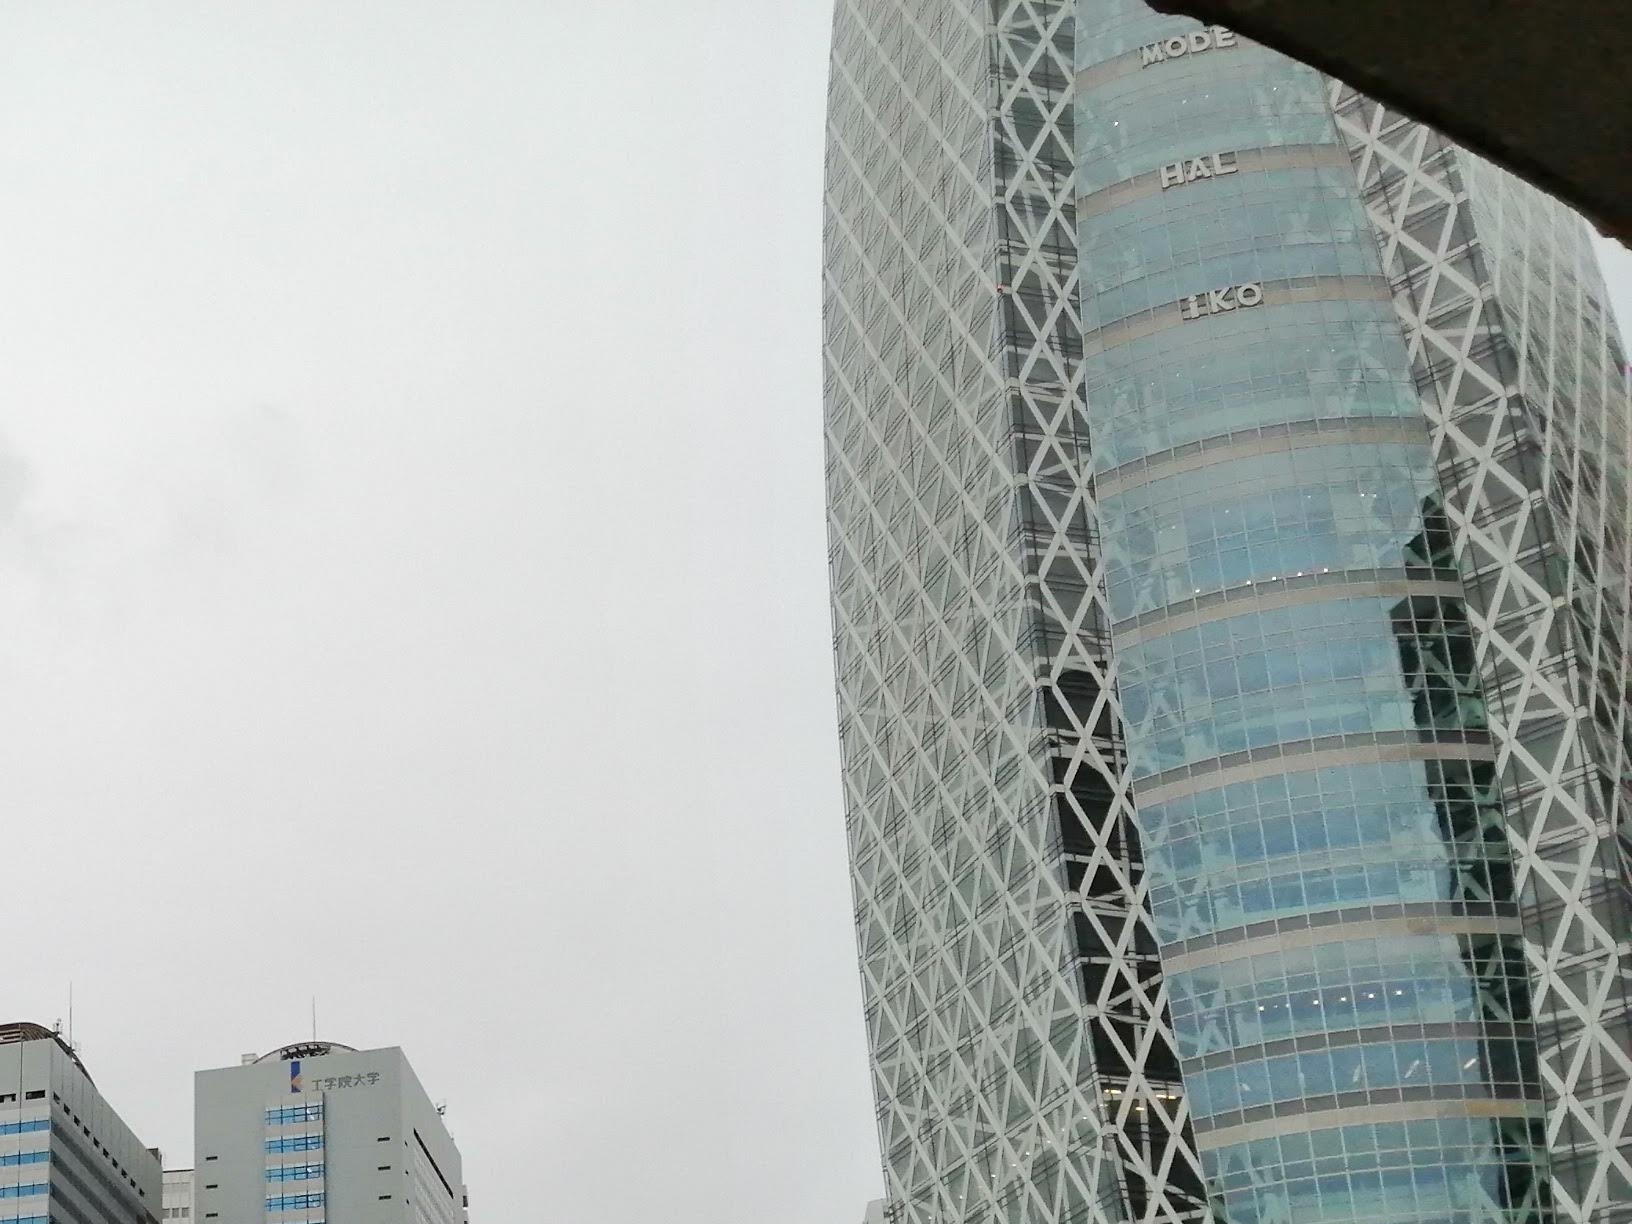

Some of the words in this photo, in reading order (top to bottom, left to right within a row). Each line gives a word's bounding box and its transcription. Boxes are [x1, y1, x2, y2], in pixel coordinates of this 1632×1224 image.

[1141, 24, 1236, 67] MODE
[1160, 153, 1238, 189] HAL
[311, 1072, 381, 1092] 工学院大学
